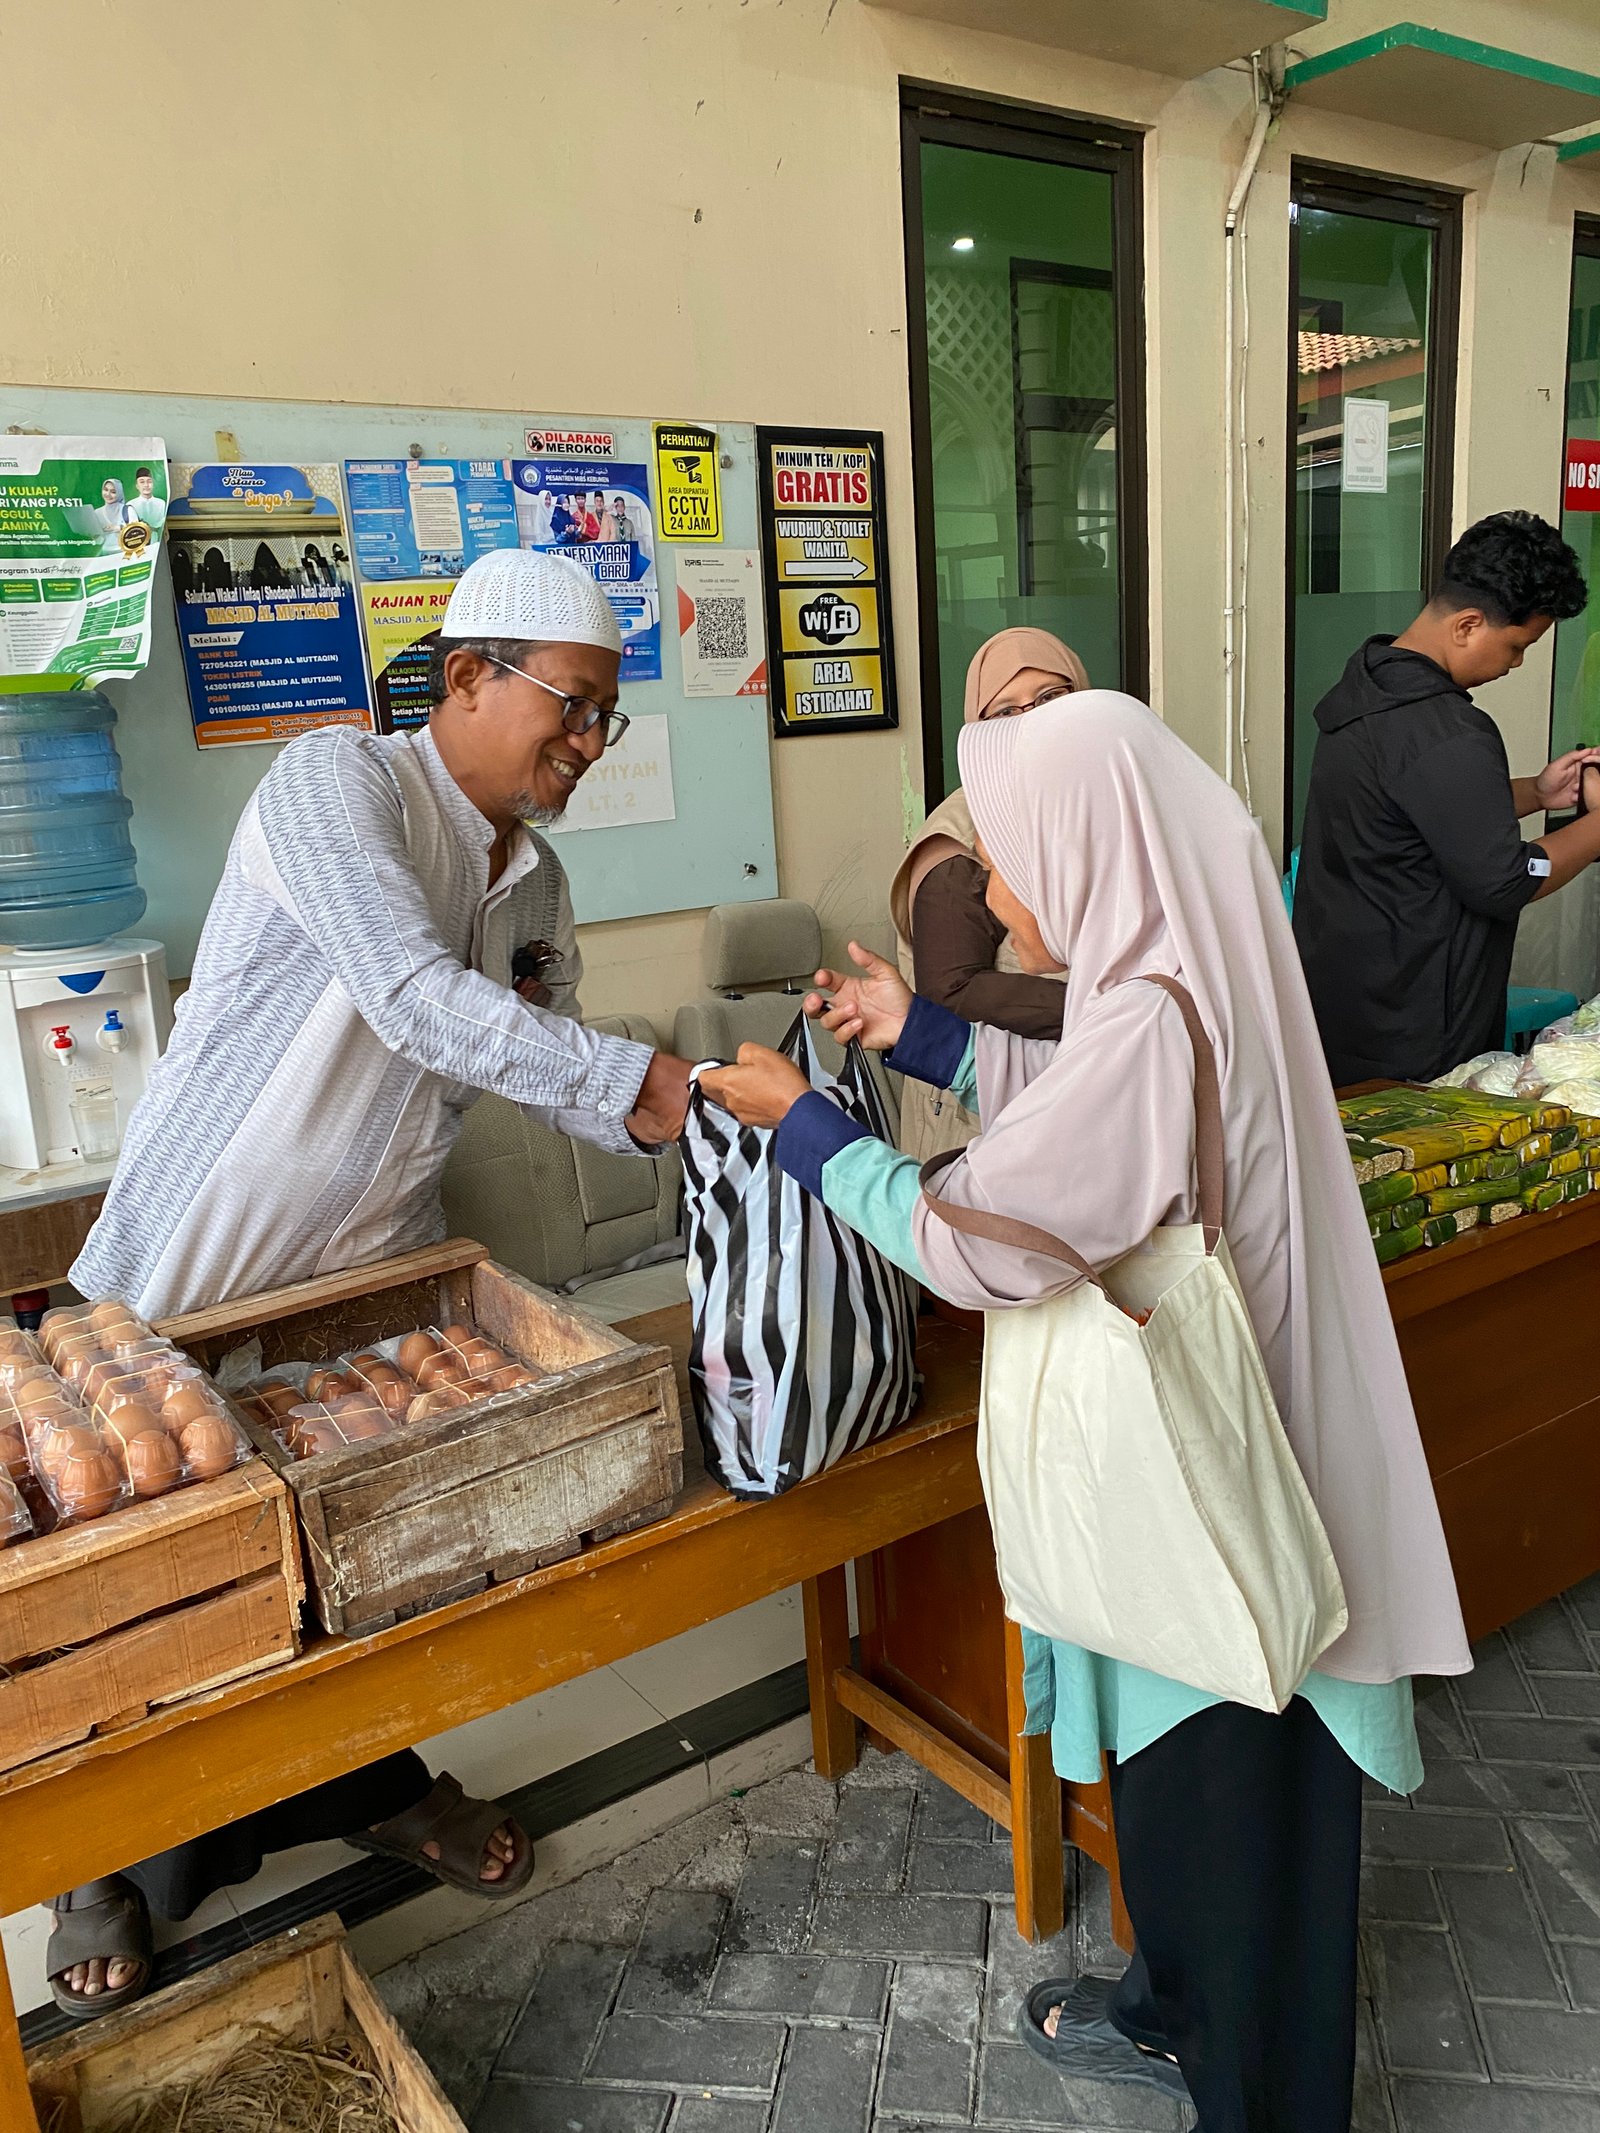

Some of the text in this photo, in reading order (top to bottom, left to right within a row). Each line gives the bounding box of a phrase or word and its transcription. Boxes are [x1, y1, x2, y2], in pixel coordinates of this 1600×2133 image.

[545, 432, 612, 445] DILARANG
[660, 433, 710, 447] PERHATIAN
[546, 443, 612, 454] MEROKOK
[776, 451, 812, 467] MINUM
[815, 453, 833, 467] TEH
[843, 454, 866, 469] KOPI
[228, 468, 255, 478] Mau
[1568, 462, 1586, 489] NO
[222, 477, 266, 487] Istana
[777, 470, 868, 504] GRATIS
[9, 486, 58, 496] KULIAH?
[683, 487, 709, 495] DIPANTAU
[11, 498, 47, 508] YANG
[49, 498, 83, 508] PASTI
[245, 489, 282, 513] Surga
[669, 496, 709, 516] CCTV
[0, 521, 50, 531] AMINYA
[670, 517, 711, 531] 24 JAM
[778, 520, 871, 538] WUDHU & TOILET
[804, 541, 849, 559] WANITA
[600, 563, 630, 579] BARU
[185, 582, 216, 604] Salurkan
[216, 587, 238, 602] Wakaf
[264, 585, 297, 603] Shodaqoh
[300, 584, 317, 598] Amal
[318, 583, 341, 601] Jariyah
[371, 595, 424, 609] KAJIAN
[205, 602, 340, 624] MASJID AL MUTTAQIN
[373, 616, 411, 625] MASJID
[415, 615, 429, 623] AL
[804, 610, 852, 631] WiFi
[193, 637, 231, 645] Melalui
[200, 661, 248, 670] 7270543221
[250, 658, 283, 668] (MASJID
[296, 655, 339, 664] MUTTAQIN)
[814, 661, 853, 685] AREA
[204, 680, 256, 691] 14300199255
[257, 679, 289, 689] (MASJID
[301, 675, 342, 684] MUTTAQIN)
[209, 703, 261, 714] 01010010033
[262, 702, 294, 711] (MASJID
[306, 697, 347, 706] MUTTAQIN)
[796, 689, 873, 715] ISTIRAHAT
